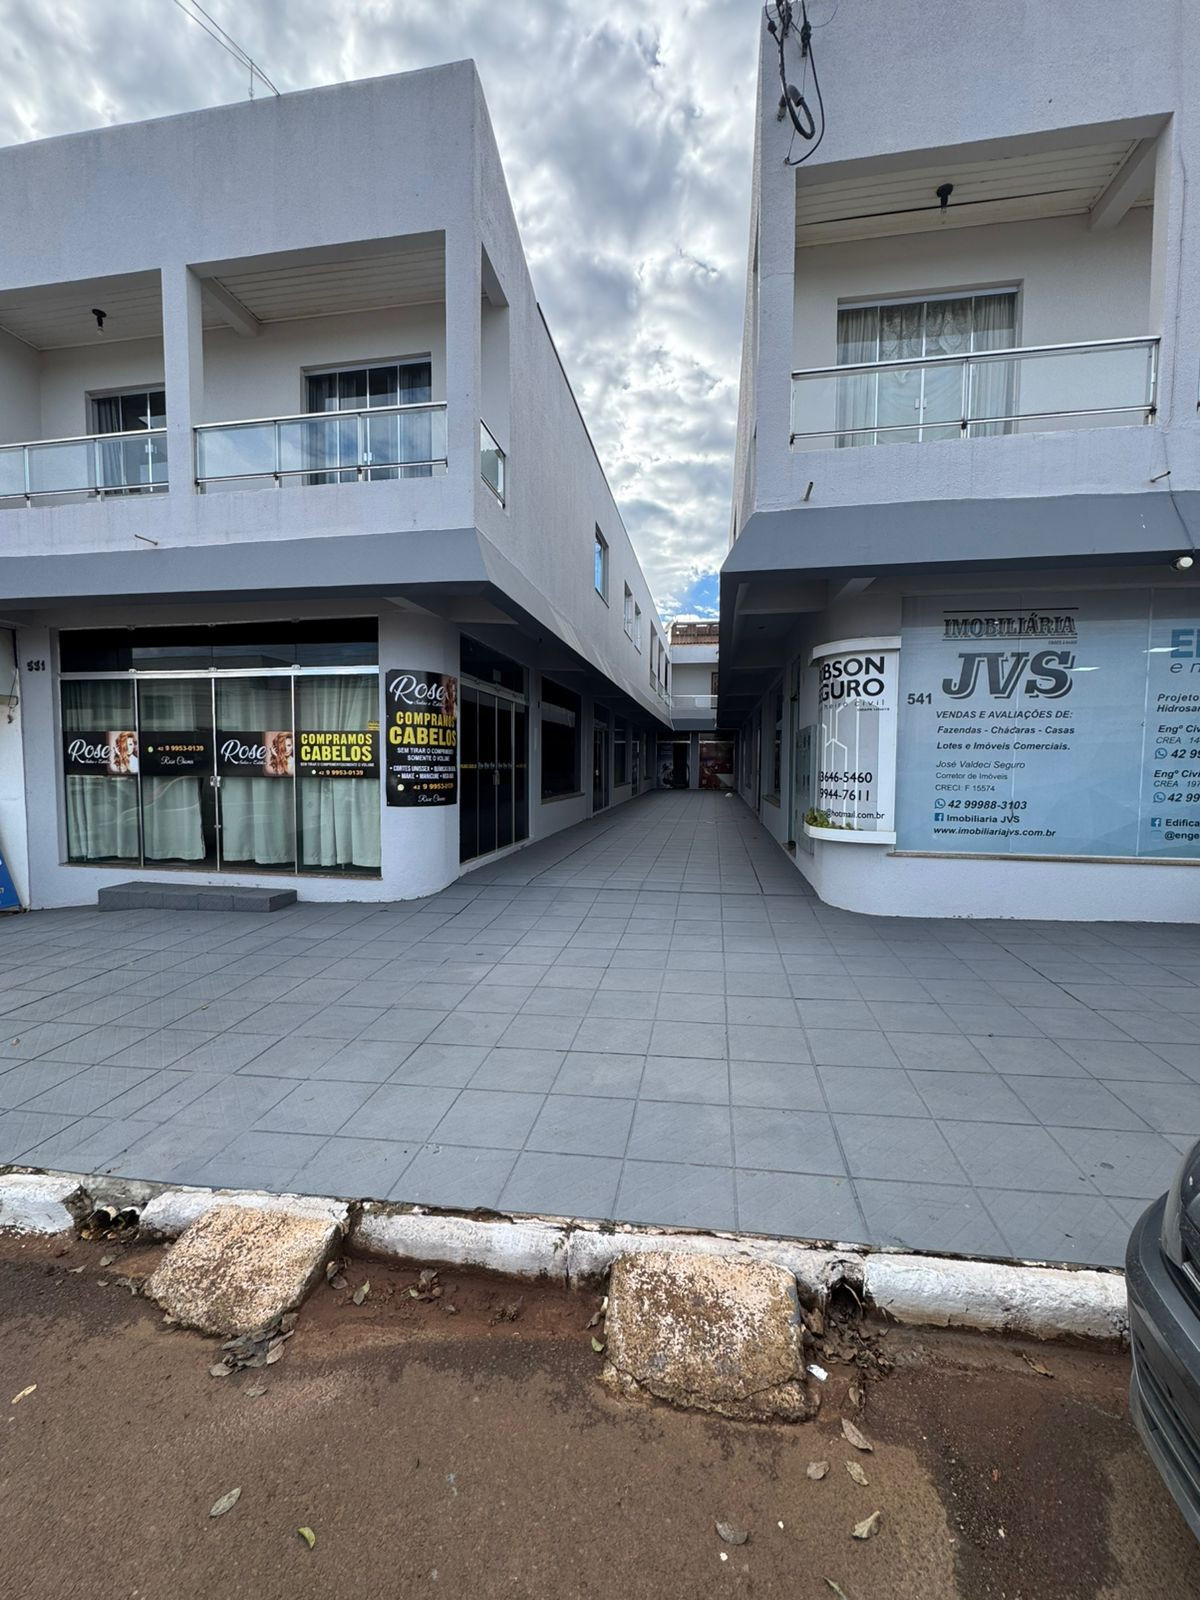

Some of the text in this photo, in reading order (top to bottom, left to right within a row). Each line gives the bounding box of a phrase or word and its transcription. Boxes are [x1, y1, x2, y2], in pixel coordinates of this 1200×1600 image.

[943, 612, 1077, 638] IMOBILIÁRIA
[818, 656, 885, 681] BSON
[942, 650, 1075, 699] JVS
[389, 674, 446, 705] Rose
[907, 692, 932, 705] 541
[988, 709, 1052, 720] AVALIAÇÕES
[937, 726, 981, 734] Fazendas
[991, 726, 1035, 734] Chácaras
[1045, 726, 1075, 734] Casas
[301, 733, 373, 745] COMPRAMOS
[389, 726, 457, 746] CABELOS
[68, 738, 111, 764] Rose
[937, 741, 962, 750] Lotes
[973, 741, 1010, 750] Imóveis
[1013, 742, 1070, 750] Comerciais.
[220, 739, 268, 765] Rose
[301, 745, 373, 762] CABELOS
[1171, 749, 1186, 759] 42
[935, 760, 1025, 770] José Valdeci Seguro
[979, 772, 1008, 780] Imóveis
[1167, 793, 1183, 802] 42
[948, 800, 1027, 810] 42 99988-3103
[947, 814, 1020, 823] Imobiliaria JVS
[933, 827, 1056, 838] www.imobiliariajvs.com.br
